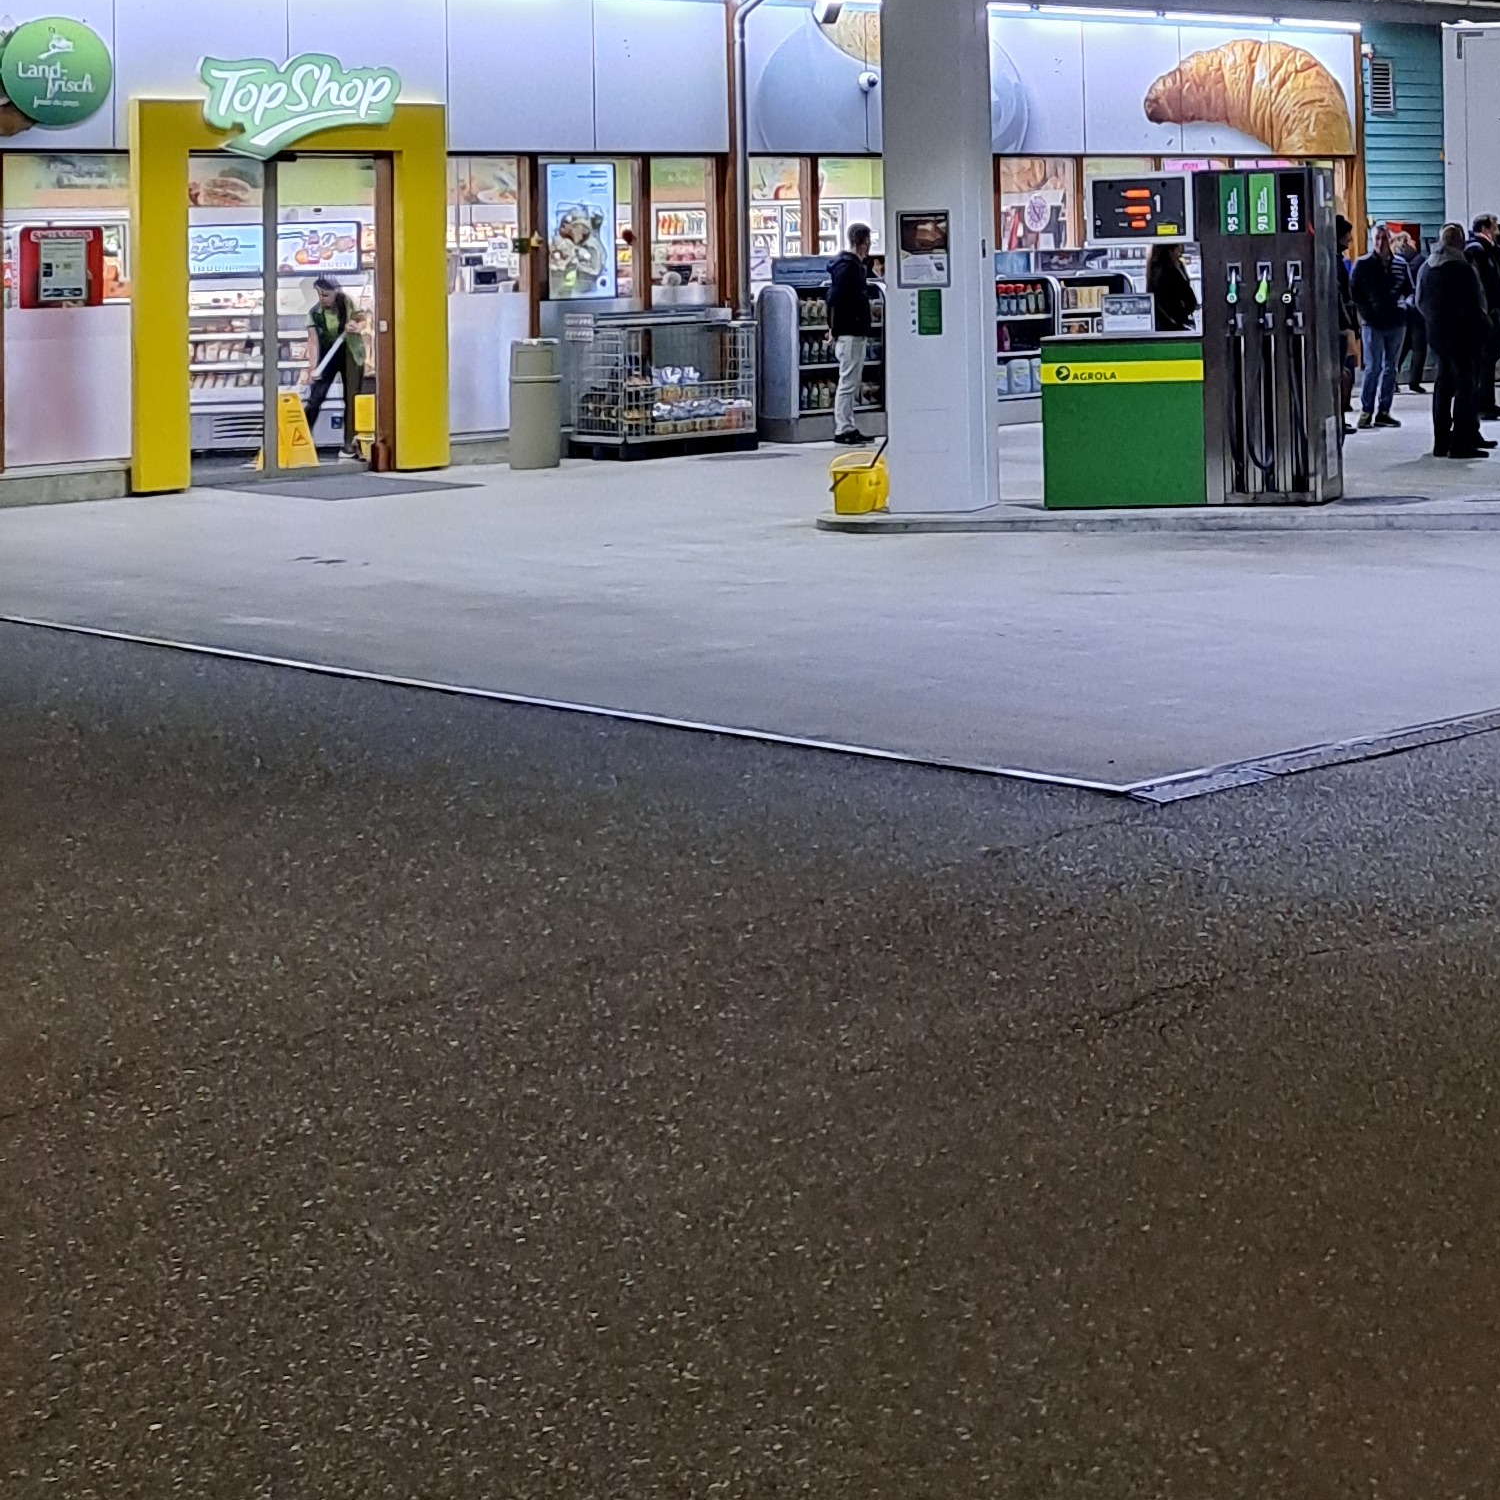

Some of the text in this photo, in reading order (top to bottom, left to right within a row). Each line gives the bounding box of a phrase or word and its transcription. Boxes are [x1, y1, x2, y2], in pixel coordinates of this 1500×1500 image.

[18, 61, 68, 78] Land-
[1153, 194, 1161, 213] 1
[1286, 194, 1299, 231] Diesel
[1227, 216, 1239, 232] 95
[1071, 372, 1117, 381] AGROLA
